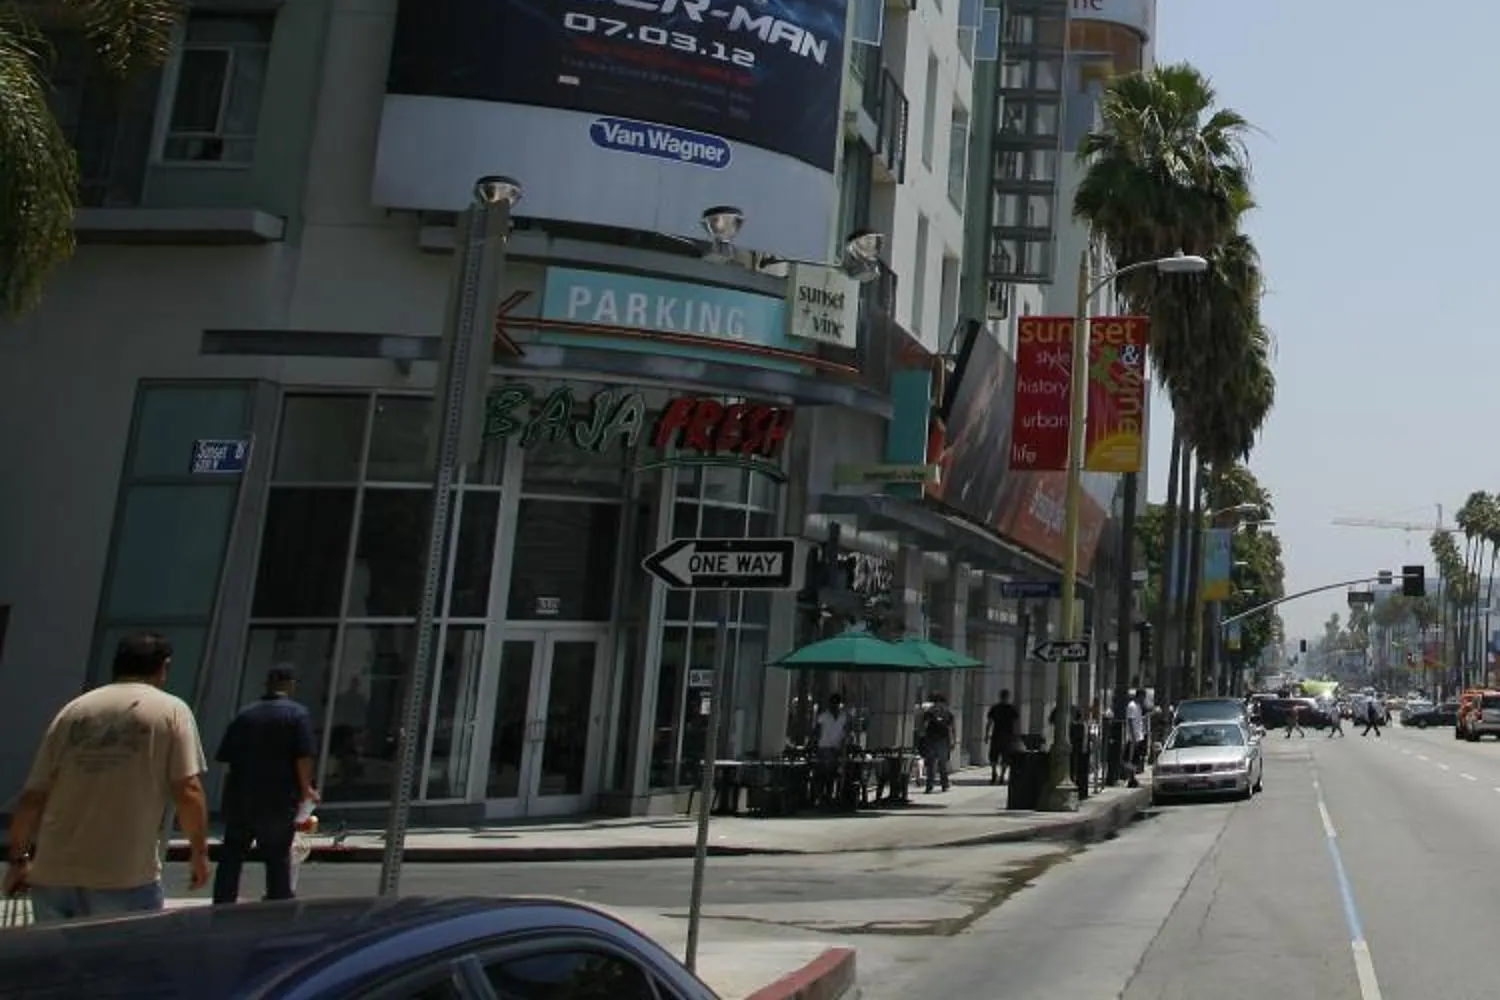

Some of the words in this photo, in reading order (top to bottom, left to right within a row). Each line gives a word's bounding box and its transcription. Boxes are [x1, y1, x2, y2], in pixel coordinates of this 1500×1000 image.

[563, 12, 756, 68] 07.03.12
[600, 119, 646, 149] Van
[648, 128, 726, 165] Wagner
[799, 285, 845, 310] sunset
[567, 285, 746, 338] PARKING
[812, 312, 845, 339] vine
[1035, 346, 1070, 371] style
[1017, 376, 1068, 400] history
[484, 384, 647, 453] BAJA
[654, 396, 794, 458] FRESH
[1023, 410, 1068, 429] urban
[1012, 443, 1037, 464] life
[688, 555, 728, 573] ONE
[737, 555, 777, 573] WAY
